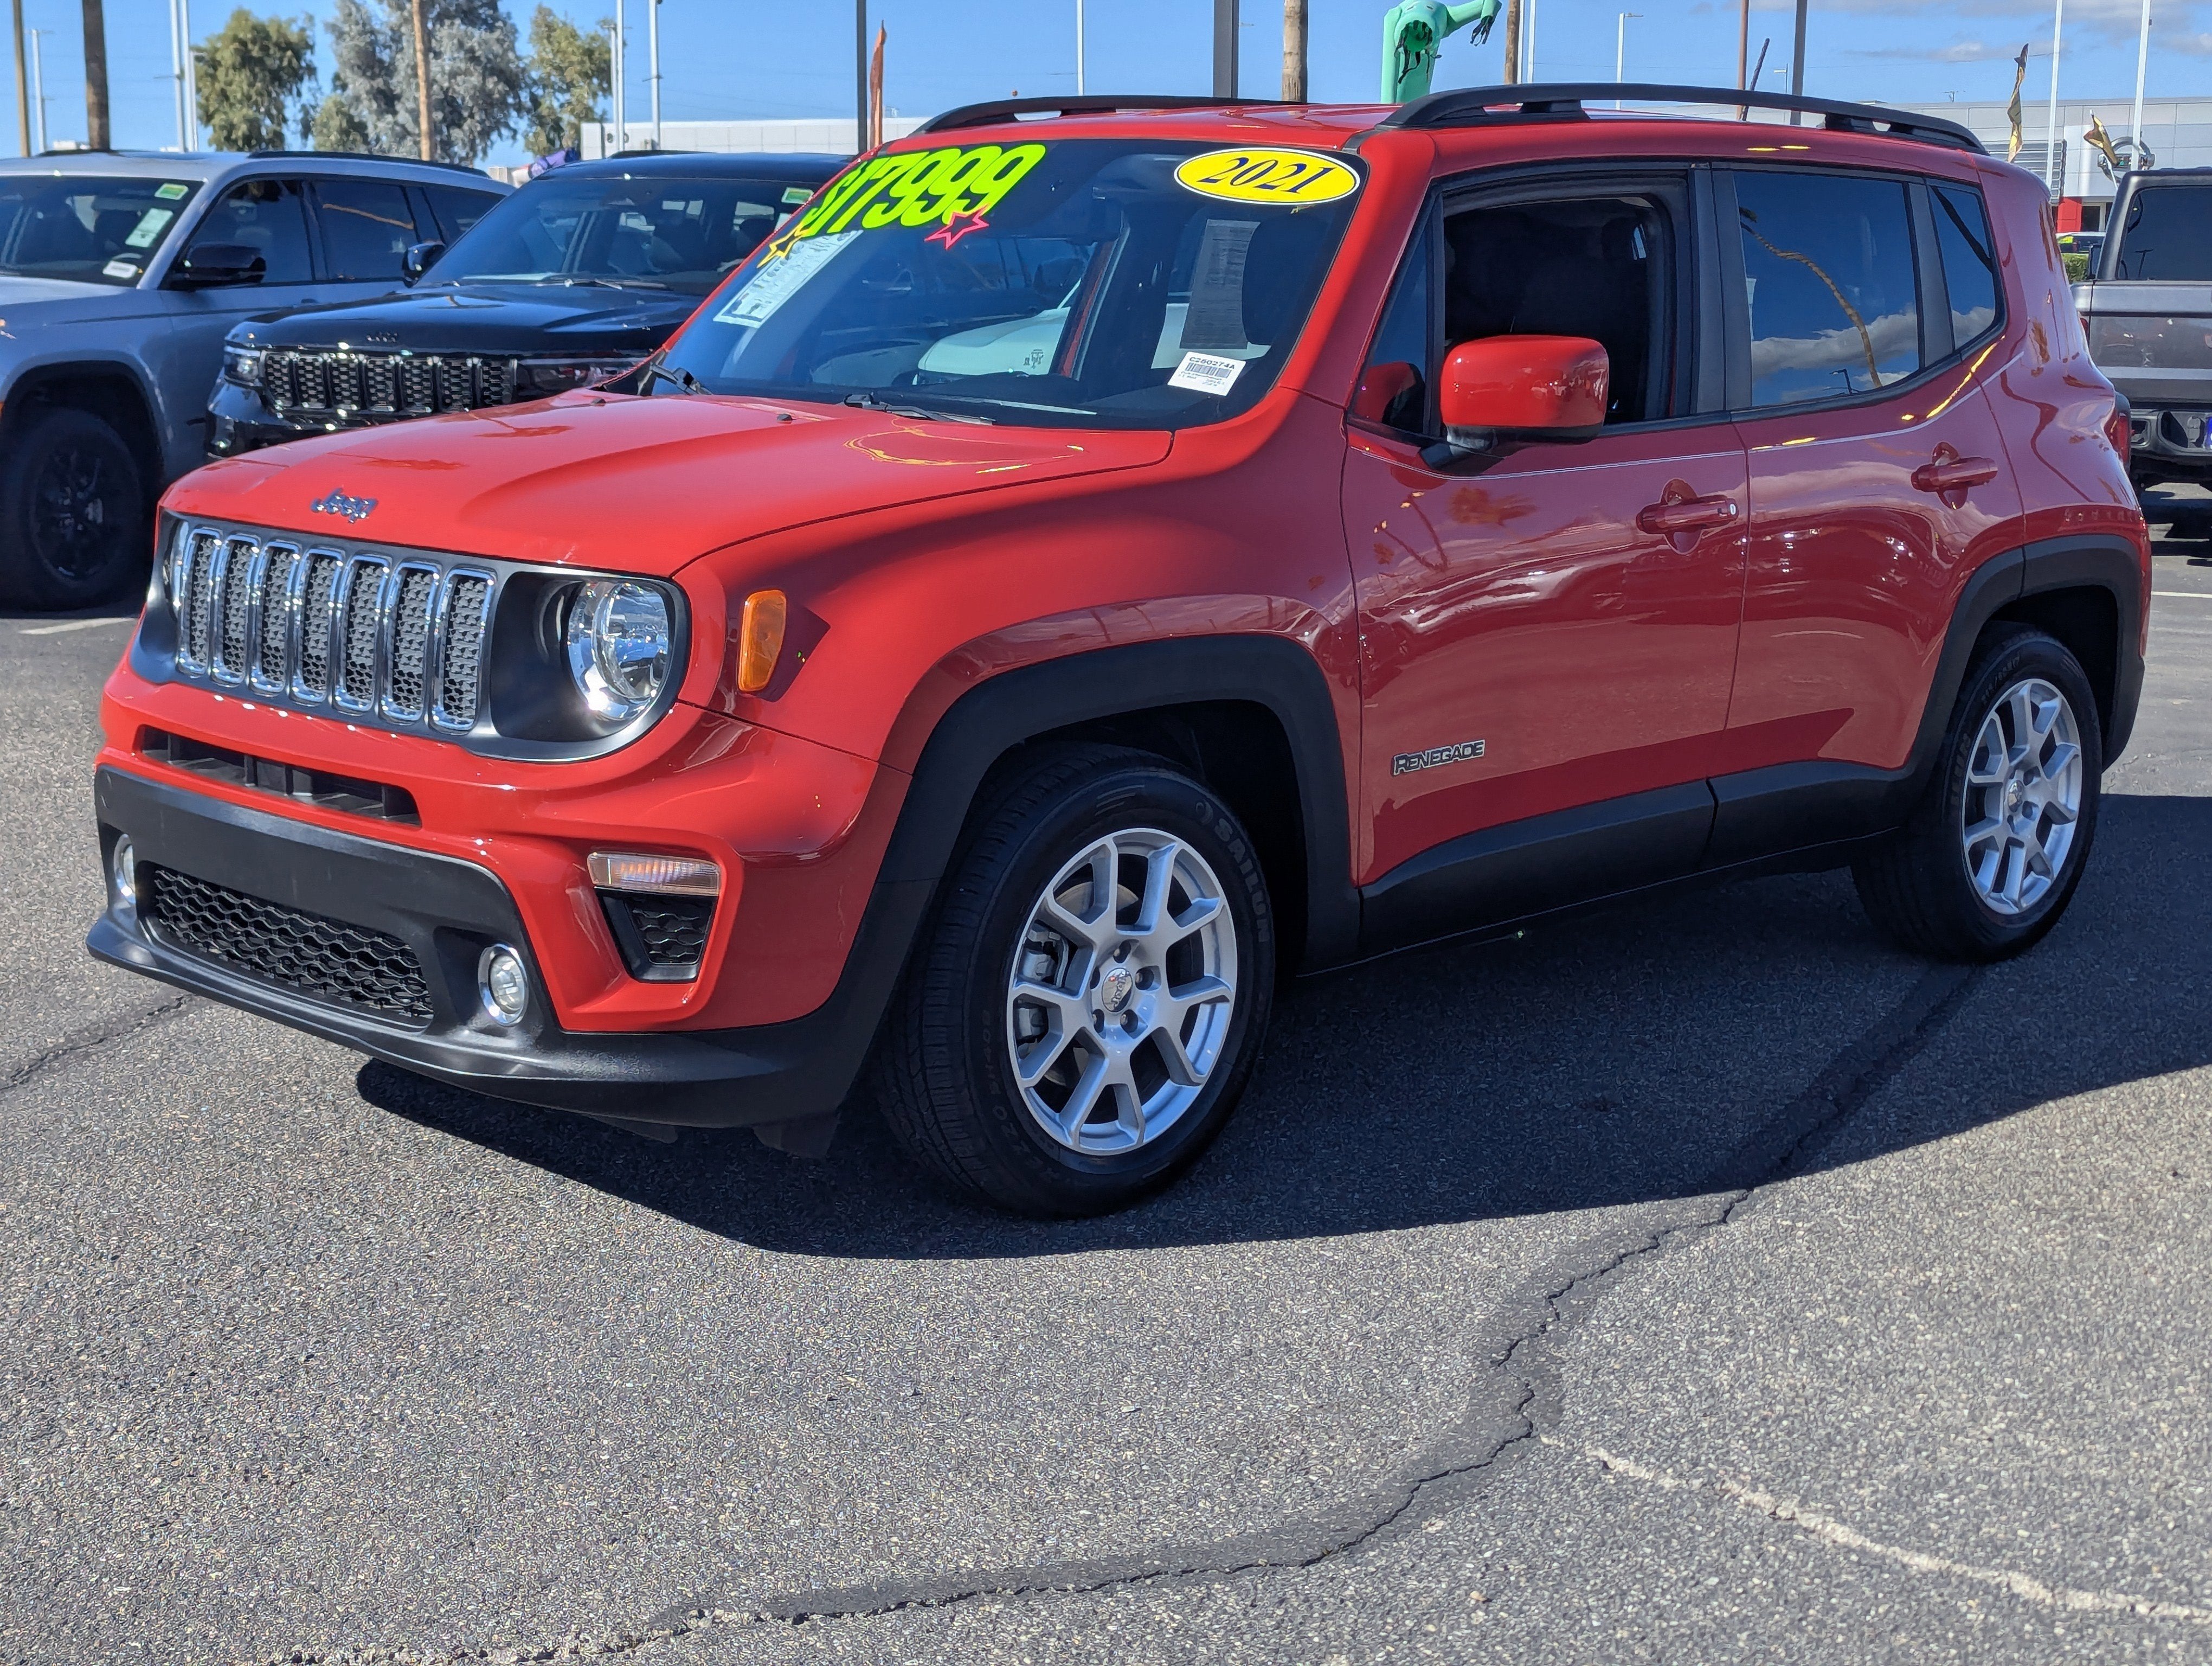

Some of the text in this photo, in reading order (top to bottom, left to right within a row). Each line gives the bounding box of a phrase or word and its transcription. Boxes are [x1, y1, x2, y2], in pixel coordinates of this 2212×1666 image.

[799, 143, 1046, 239] $17999
[1196, 156, 1338, 195] 2021
[310, 488, 378, 524] Jeep
[1392, 739, 1486, 776] RENEGADE
